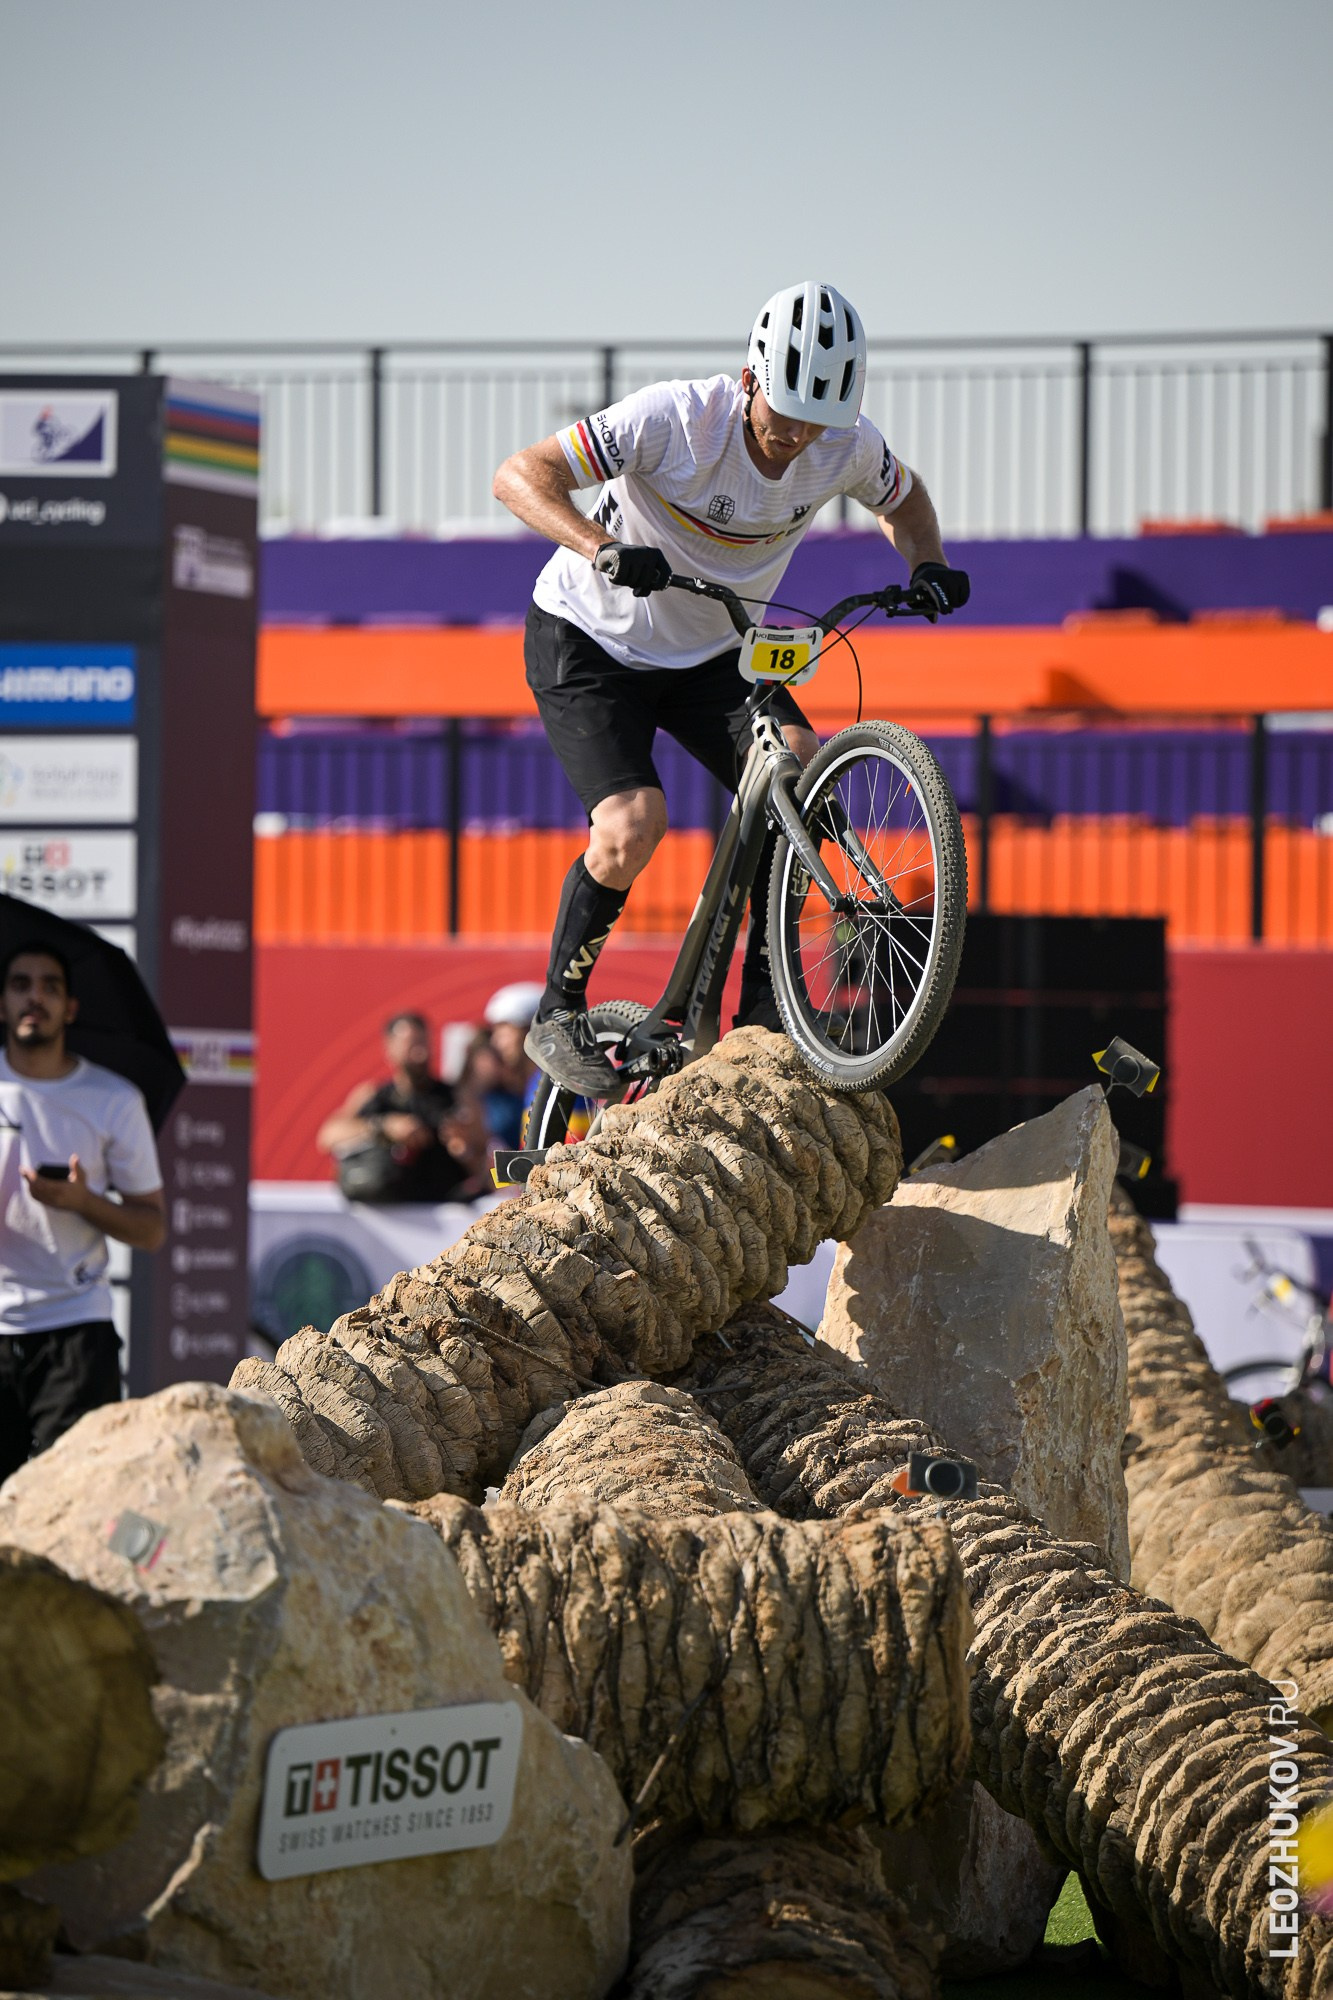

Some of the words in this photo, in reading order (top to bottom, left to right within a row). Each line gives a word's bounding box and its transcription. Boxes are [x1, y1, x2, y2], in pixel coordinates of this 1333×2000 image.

[770, 649, 796, 670] 18
[345, 1737, 501, 1808] TISSOT
[278, 1825, 327, 1855] SWISS
[331, 1814, 402, 1845] WATCHES
[406, 1806, 455, 1833] SINCE
